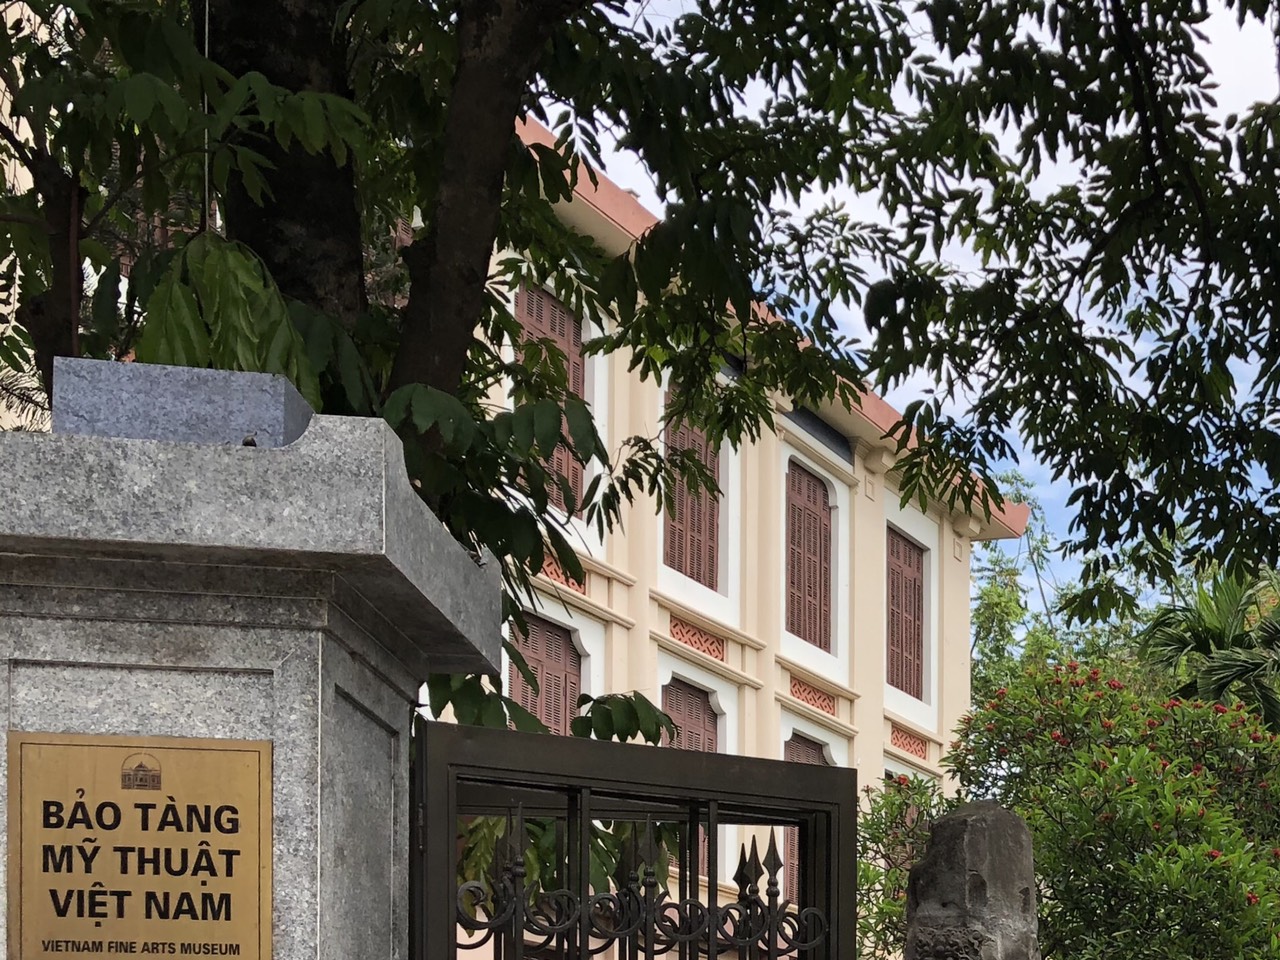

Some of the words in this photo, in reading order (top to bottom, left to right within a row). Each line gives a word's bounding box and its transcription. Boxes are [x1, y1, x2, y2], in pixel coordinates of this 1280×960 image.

[42, 788, 122, 830] BẢO
[134, 796, 239, 834] TÀNG
[42, 838, 101, 874] MỸ
[113, 841, 240, 886] THUẬT
[49, 882, 132, 927] VIỆT
[145, 892, 231, 921] NAM
[42, 940, 103, 953] VIETNAM
[108, 941, 137, 953] FINE
[141, 942, 176, 954] ARTS
[180, 943, 240, 956] MUSEUM
